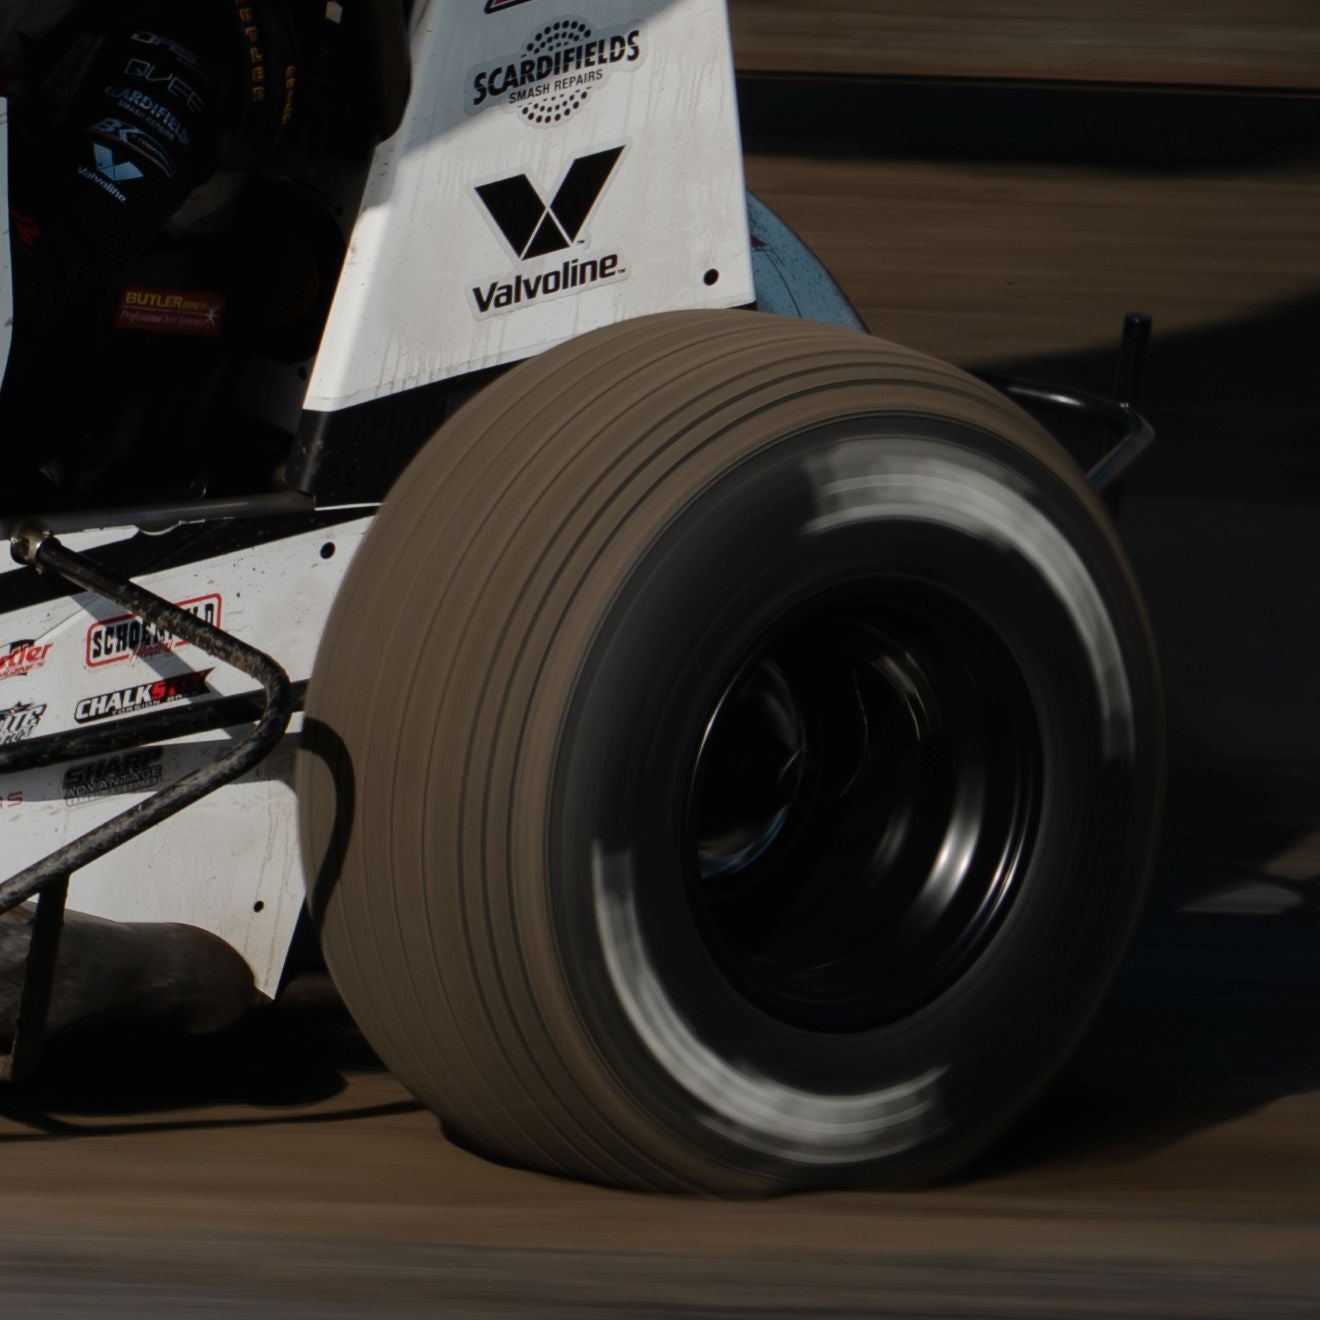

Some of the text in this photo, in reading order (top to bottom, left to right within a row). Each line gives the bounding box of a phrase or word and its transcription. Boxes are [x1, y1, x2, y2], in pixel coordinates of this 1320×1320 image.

[473, 30, 640, 106] SCARDIFIELDS
[508, 68, 604, 104] SMASH REPAIRS
[472, 253, 620, 314] Valvoline
